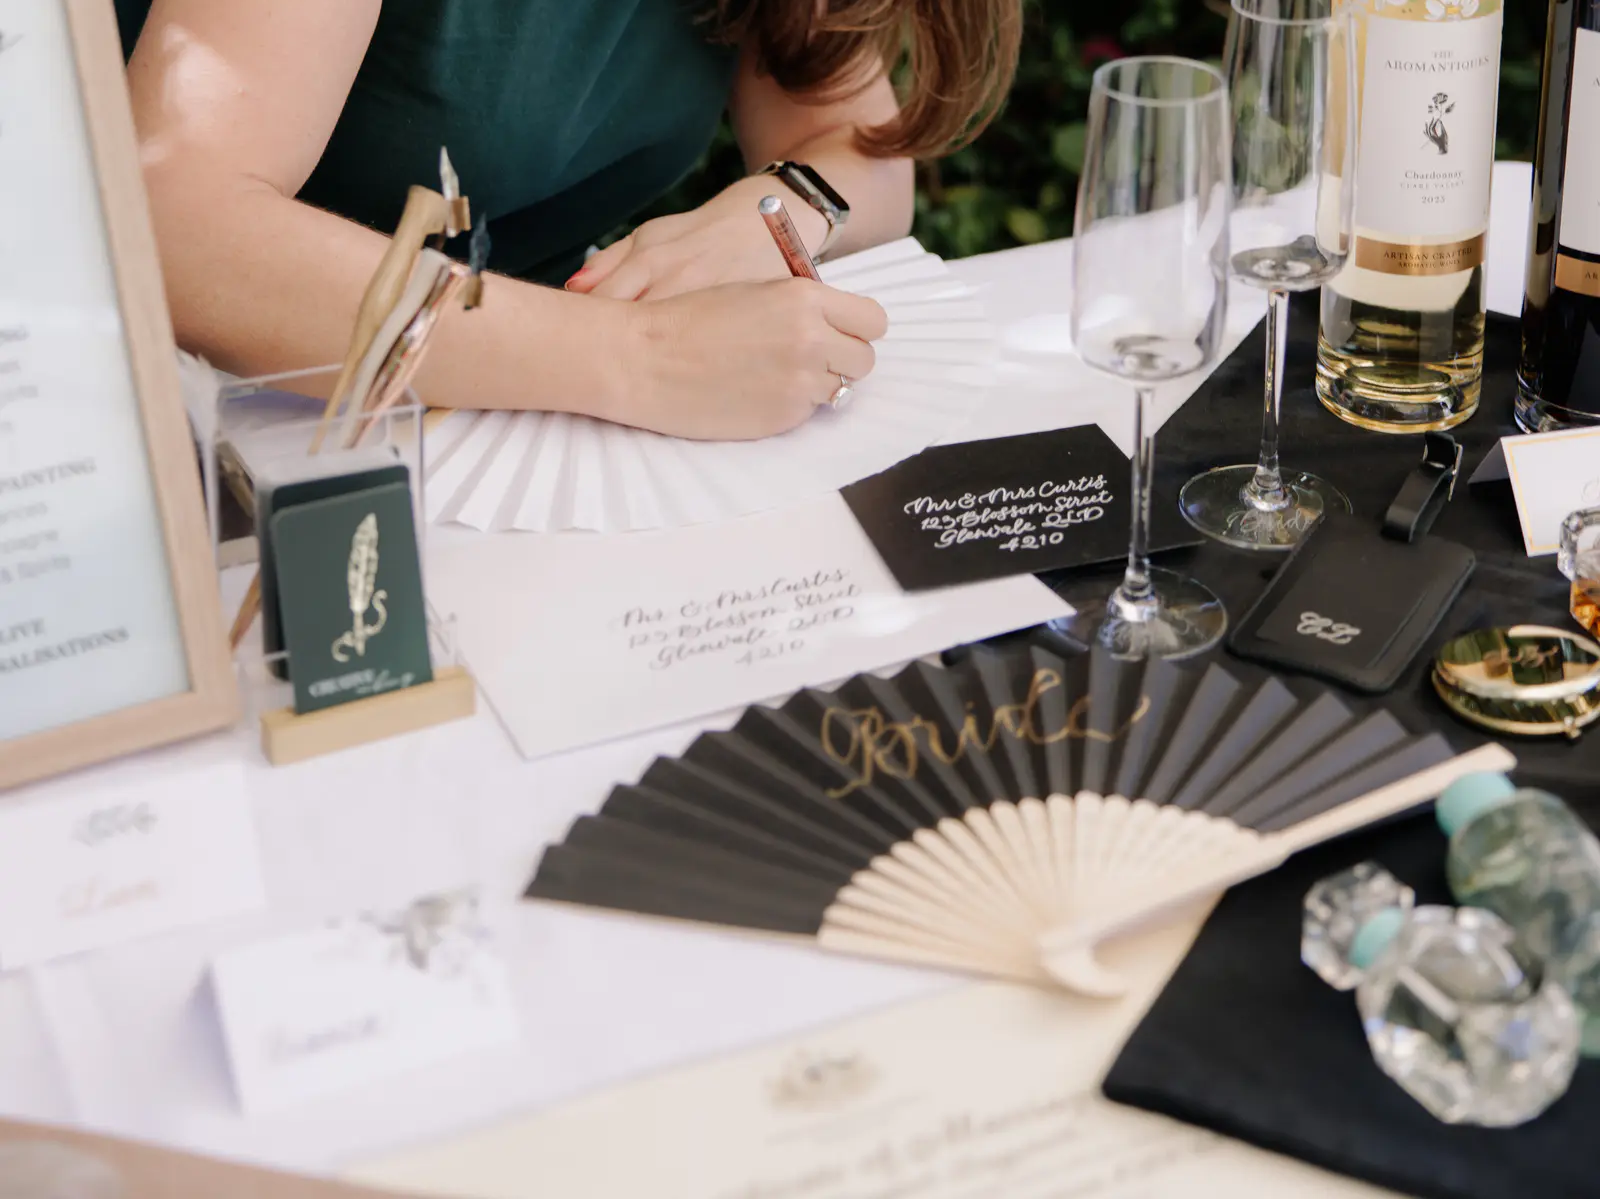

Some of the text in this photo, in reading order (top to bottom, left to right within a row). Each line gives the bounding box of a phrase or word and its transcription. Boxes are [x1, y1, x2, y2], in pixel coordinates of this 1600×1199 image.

[1404, 170, 1463, 180] Chardonnay
[1384, 247, 1472, 260] ARTISAN CRAFTED
[903, 474, 1108, 515] Mr & Mrs Curtis
[921, 492, 1114, 531] 123 Blossom Street
[934, 506, 1104, 548] Glenvale QLD
[999, 532, 1064, 551] 4210
